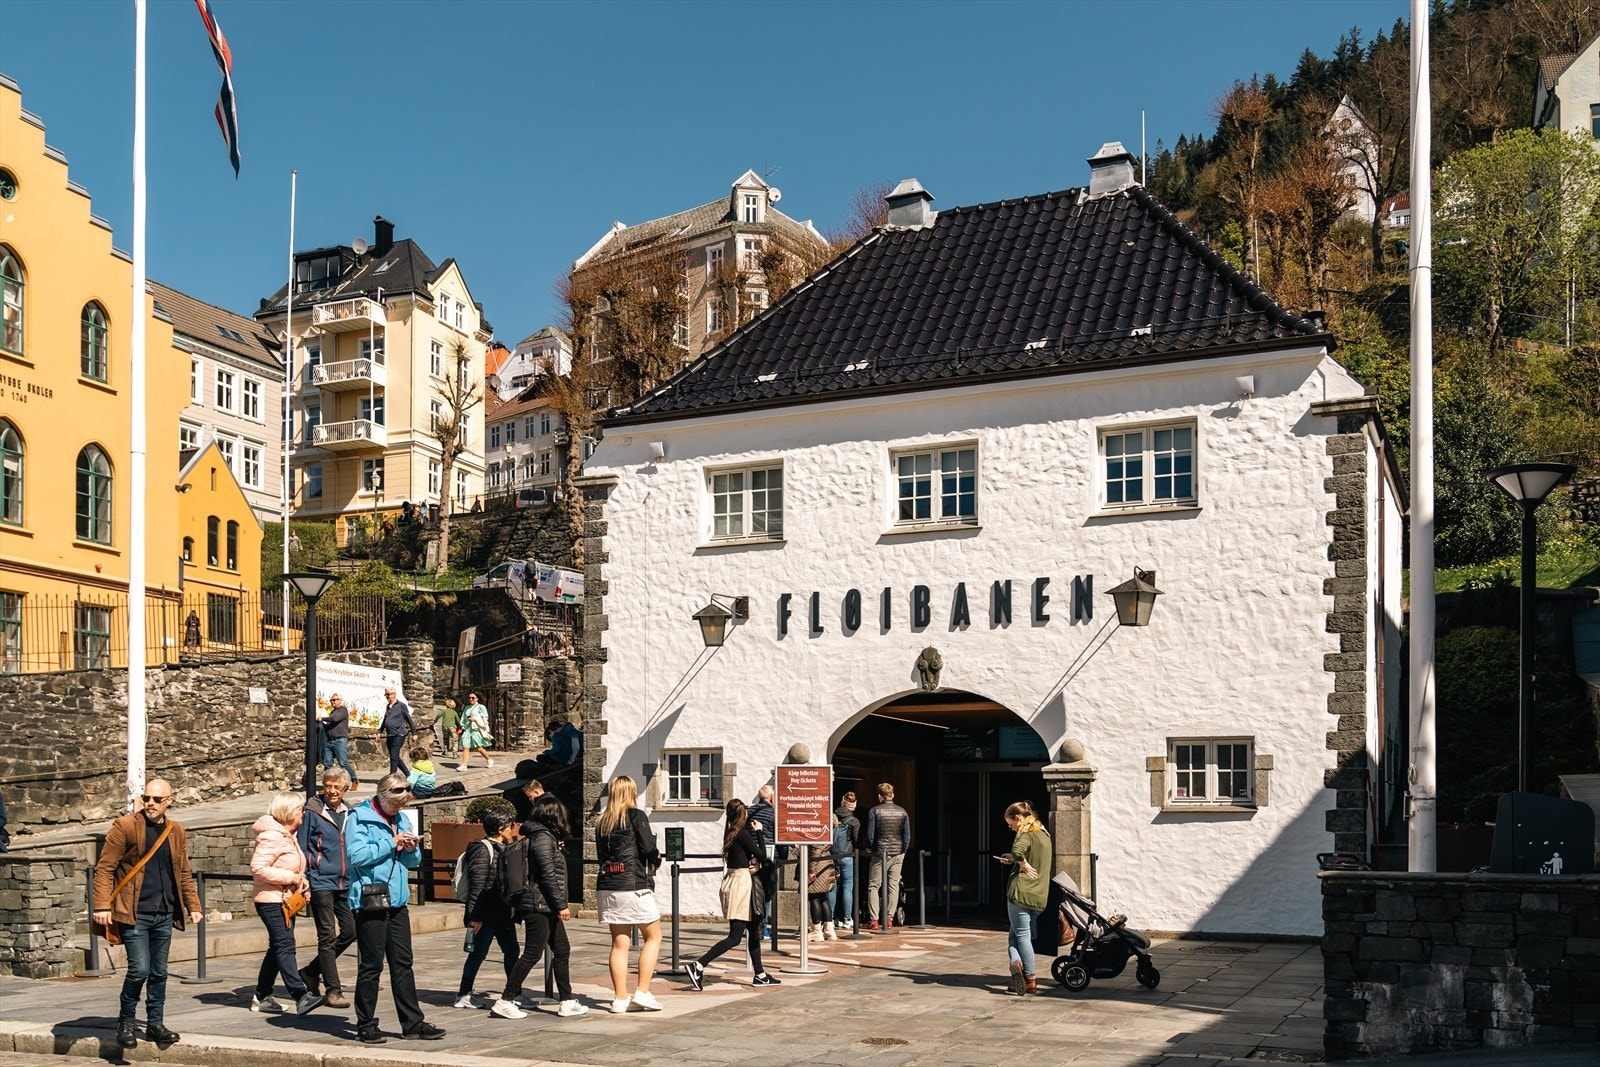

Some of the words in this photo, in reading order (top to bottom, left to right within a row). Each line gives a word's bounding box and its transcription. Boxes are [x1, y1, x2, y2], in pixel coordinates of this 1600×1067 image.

[12, 392, 27, 403] 1740
[27, 383, 53, 399] SKOLER
[779, 574, 1094, 636] FLØIBANEN
[333, 668, 353, 677] Krybbe
